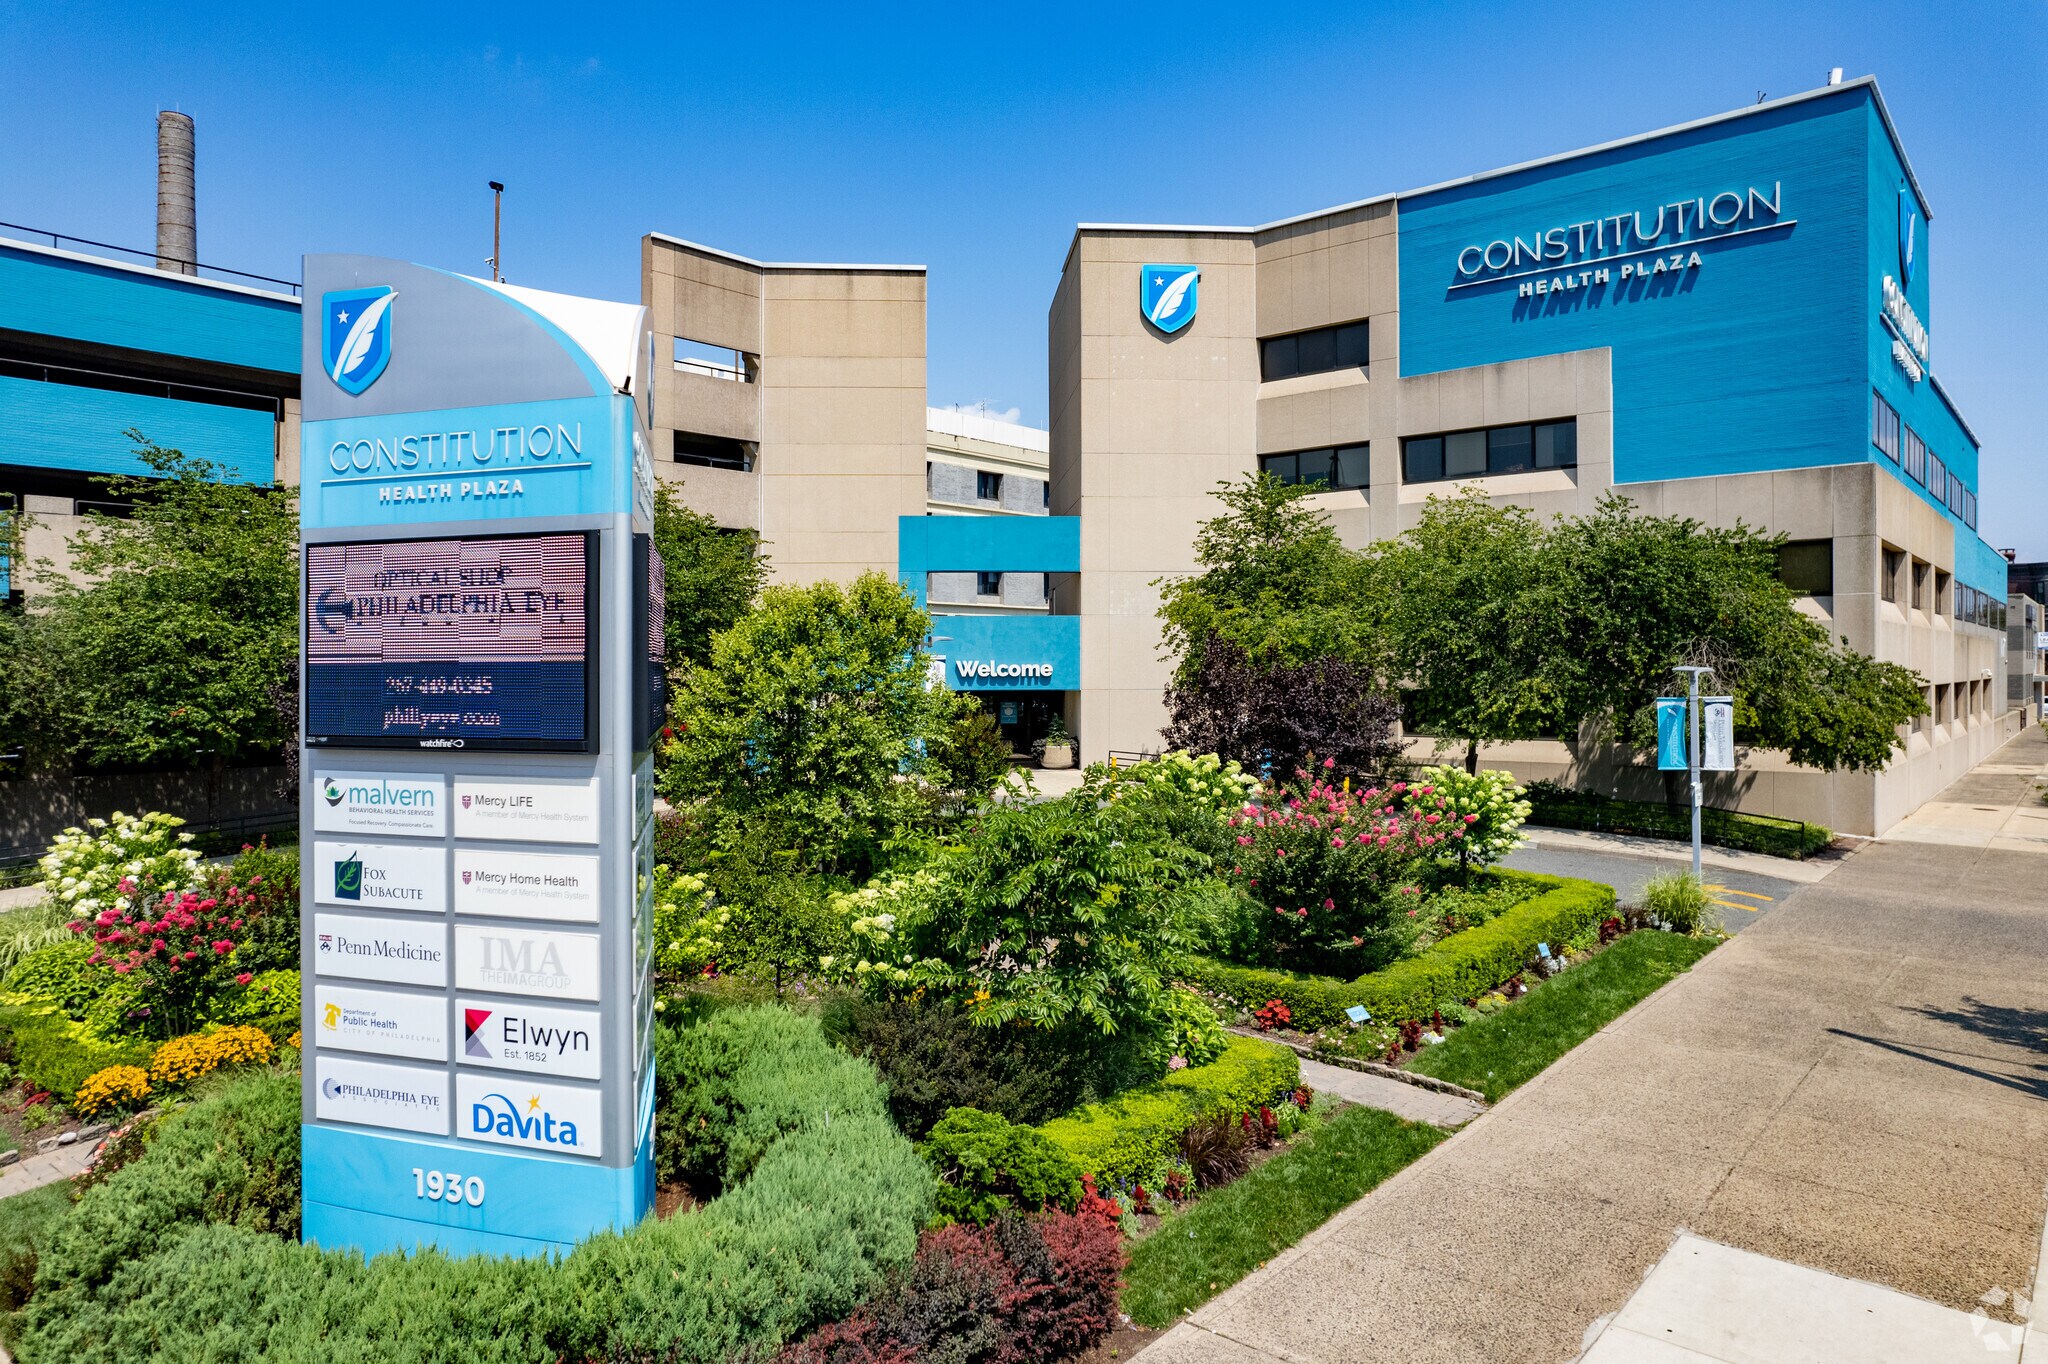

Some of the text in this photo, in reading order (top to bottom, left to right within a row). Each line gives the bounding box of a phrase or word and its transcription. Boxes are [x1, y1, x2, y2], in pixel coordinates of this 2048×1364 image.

[1457, 181, 1781, 275] CONSTITUTION
[1519, 251, 1703, 298] HEALTH PLAZA
[329, 422, 582, 472] CONSTITUTION
[379, 479, 524, 502] HEALTH PLAZA
[956, 659, 1054, 677] Welcome
[420, 739, 452, 747] watchfire
[349, 779, 434, 807] malvern
[475, 795, 533, 808] Mercy LIFE
[349, 807, 383, 815] BEHAVIORAL
[482, 811, 509, 819] member
[518, 812, 540, 822] Mercy
[540, 812, 562, 821] Health
[563, 813, 589, 823] System
[364, 867, 386, 880] FOX
[475, 871, 579, 887] Mercy Home Health
[363, 884, 423, 900] SUBACUTE
[482, 887, 509, 896] member
[518, 888, 540, 898] Mercy
[540, 889, 563, 898] Health
[563, 891, 590, 901] System
[337, 936, 441, 962] Penn Medicine
[480, 936, 569, 977] IMA
[343, 1008, 370, 1017] Department
[343, 1015, 398, 1029] Public Health
[381, 1031, 441, 1043] PHILADELPHIA
[504, 1017, 589, 1056] Elwyn
[504, 1049, 547, 1063] Est. 1852
[342, 1084, 440, 1106] PHILADELPHIA EYE
[472, 1093, 578, 1147] DaVita
[413, 1168, 485, 1207] 1930
